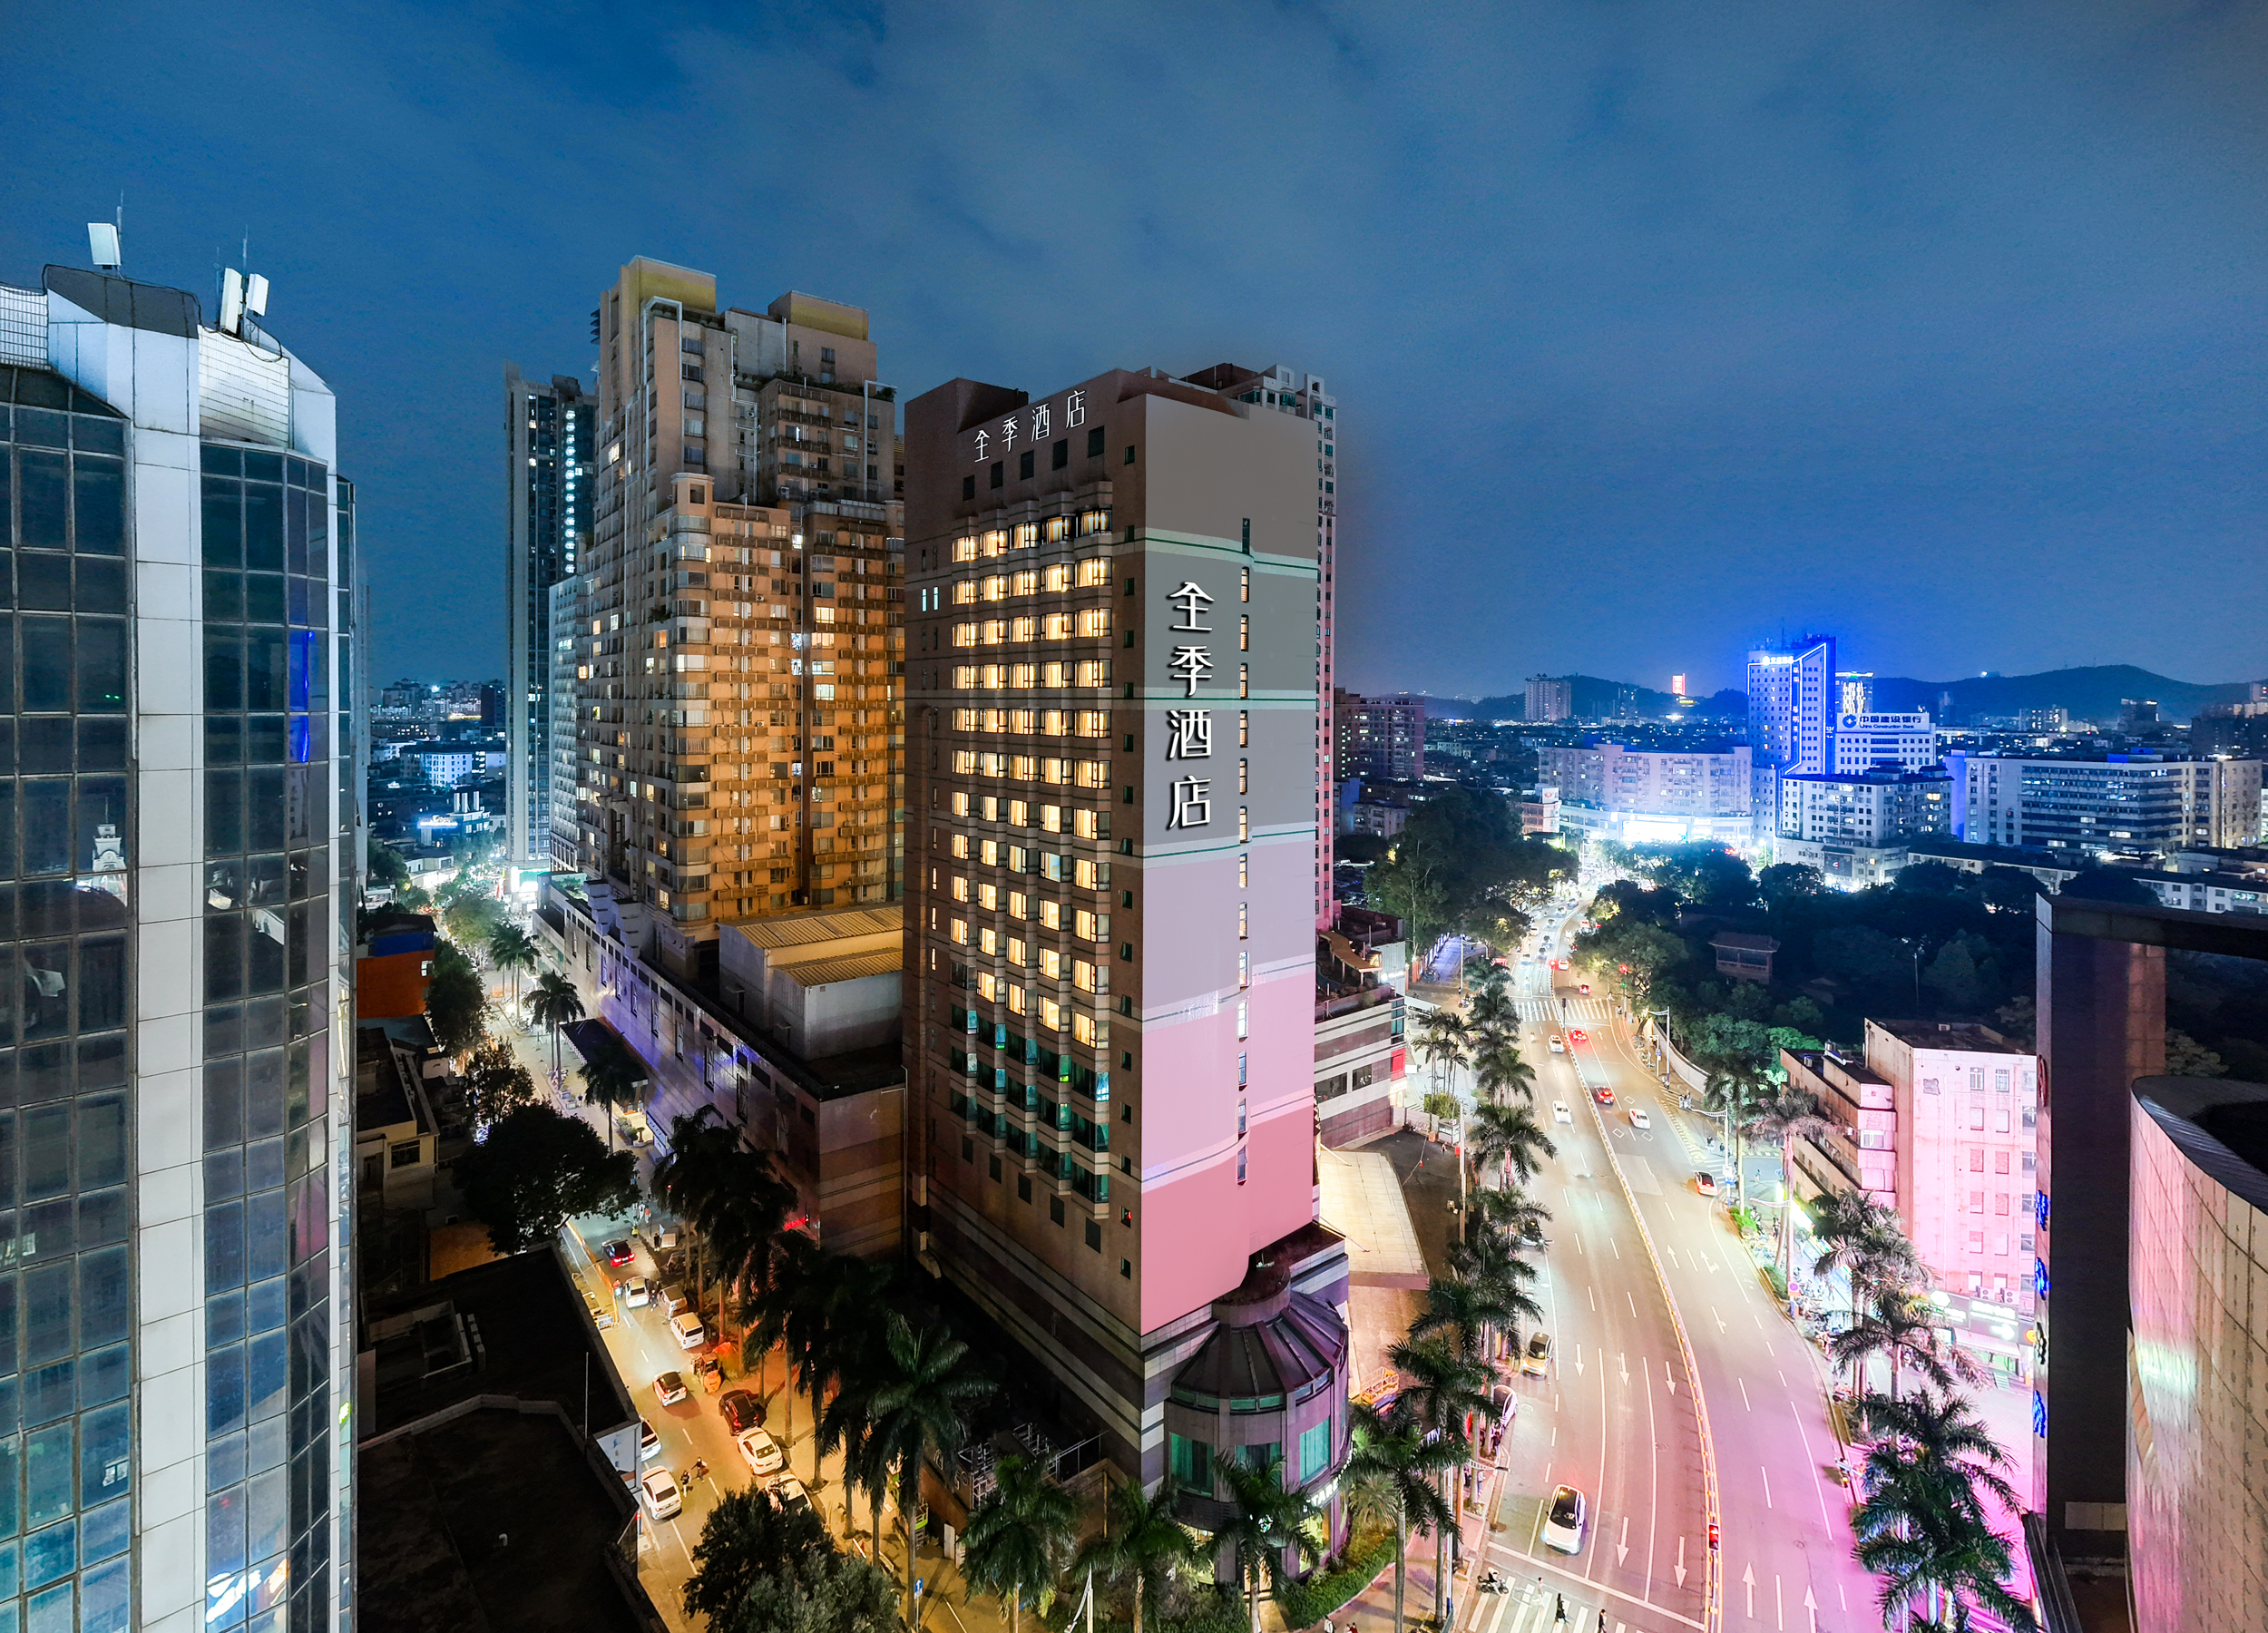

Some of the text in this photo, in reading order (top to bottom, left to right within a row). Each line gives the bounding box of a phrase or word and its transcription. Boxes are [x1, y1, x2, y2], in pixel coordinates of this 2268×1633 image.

[974, 390, 1086, 463] 全季酒店
[1168, 582, 1216, 828] 全季酒店
[1860, 715, 1921, 723] 中国建设银行
